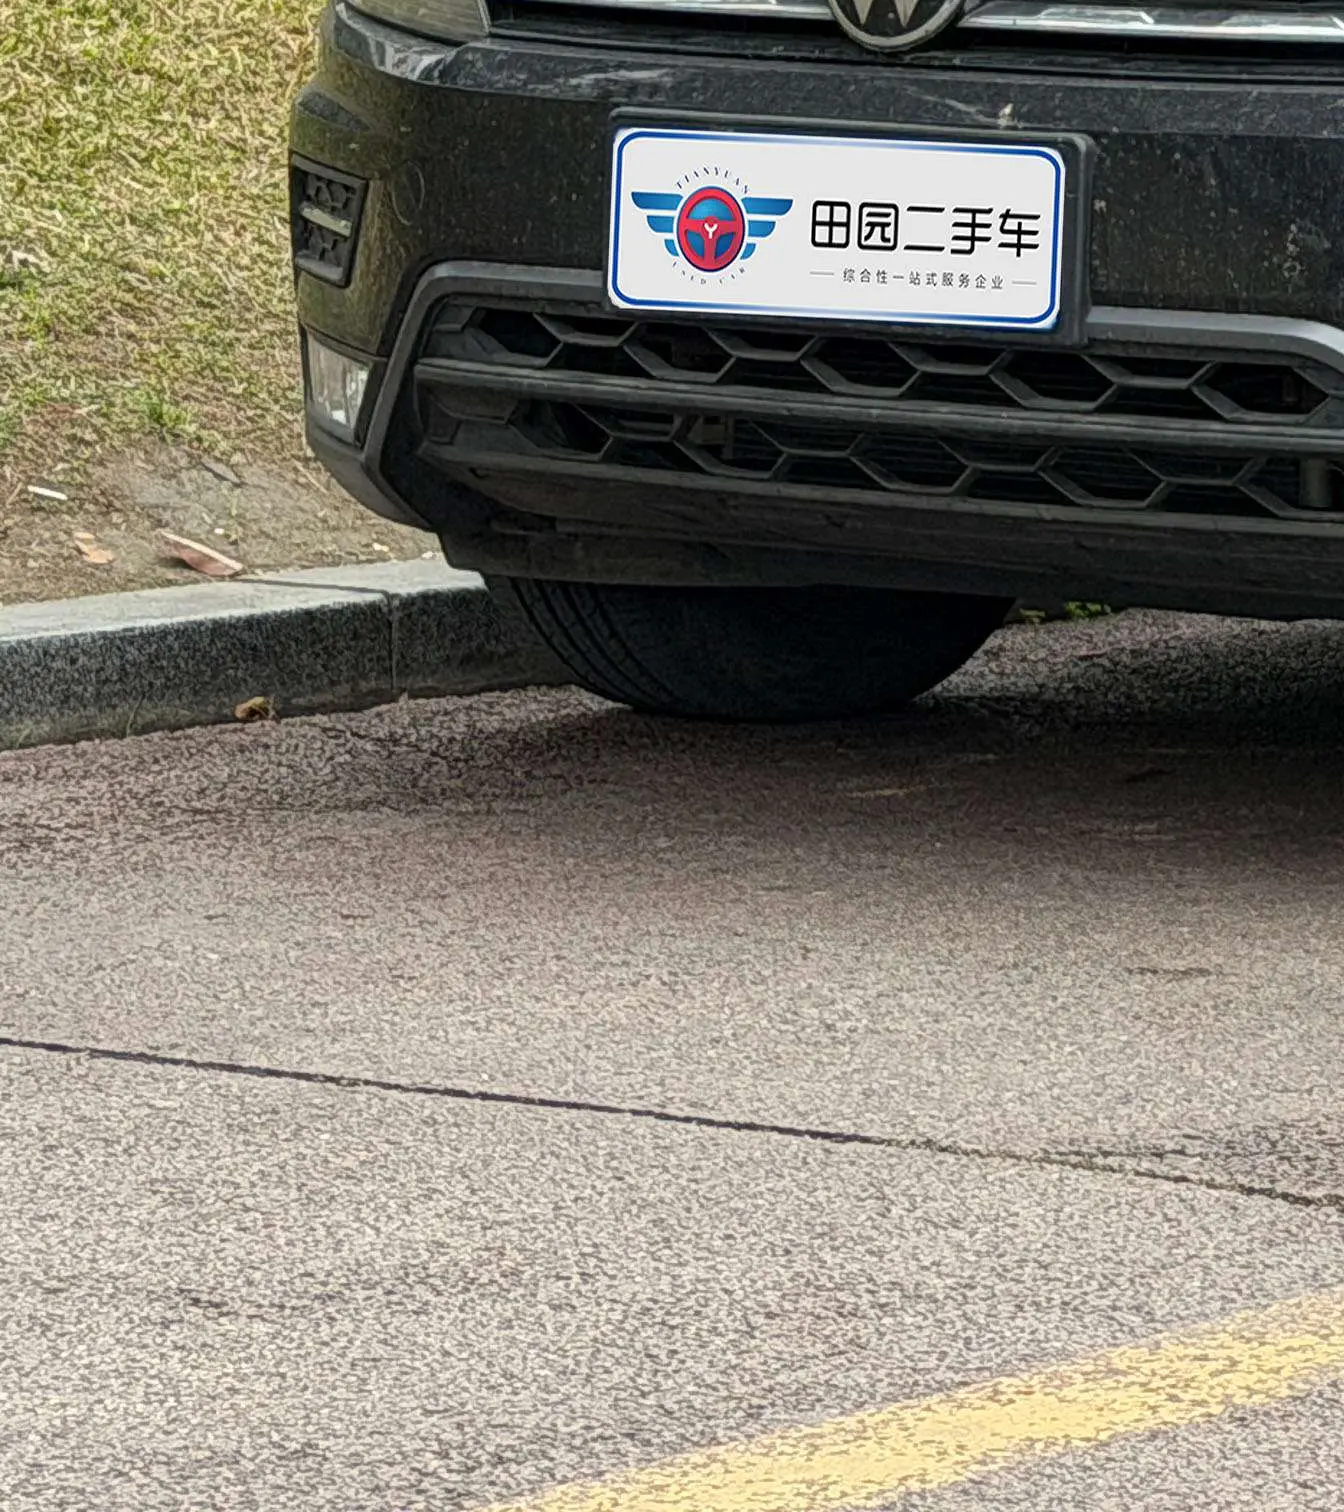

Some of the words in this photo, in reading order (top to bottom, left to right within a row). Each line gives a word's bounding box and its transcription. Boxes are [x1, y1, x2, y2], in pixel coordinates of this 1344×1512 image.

[810, 199, 1042, 258] 田园二手车
[842, 268, 1004, 289] 综合性一站式服务企业
